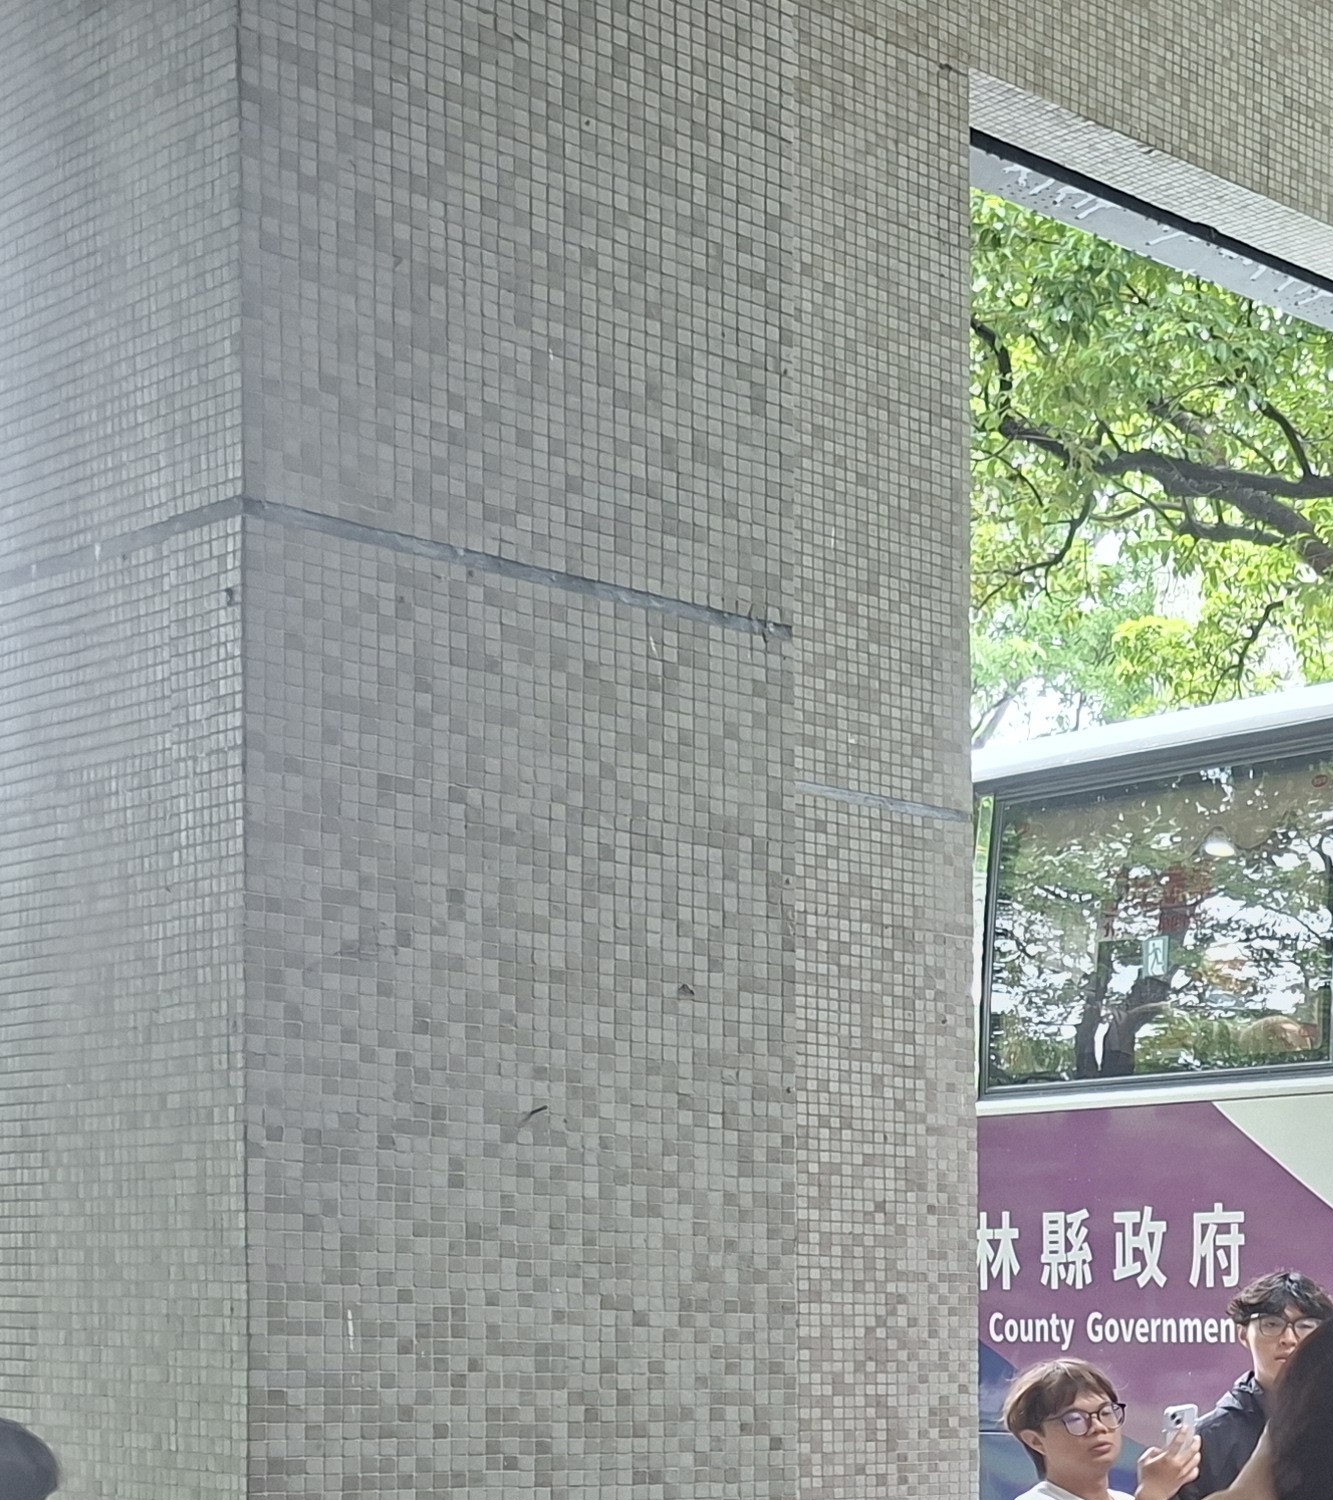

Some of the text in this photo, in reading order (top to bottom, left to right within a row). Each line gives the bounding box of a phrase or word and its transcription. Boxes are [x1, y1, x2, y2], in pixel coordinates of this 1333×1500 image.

[977, 1202, 1246, 1291] 林縣政府
[988, 1311, 1236, 1351] County Governmen
